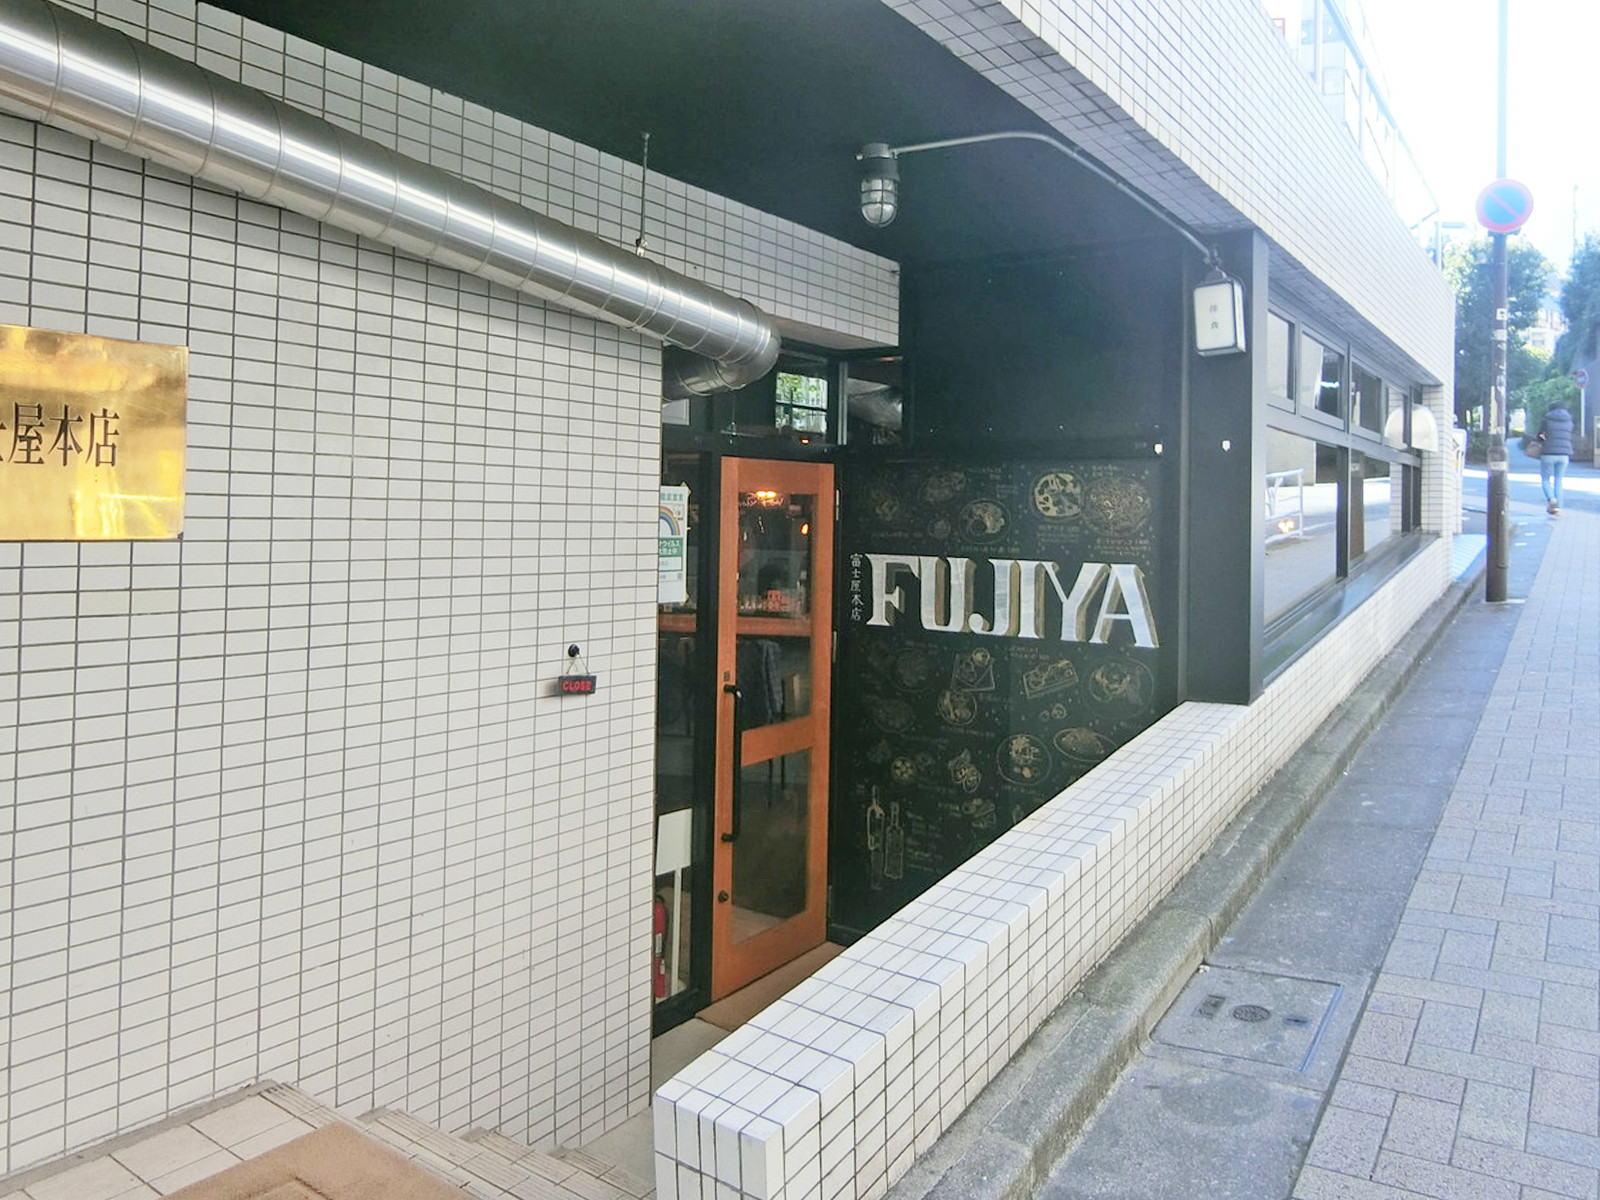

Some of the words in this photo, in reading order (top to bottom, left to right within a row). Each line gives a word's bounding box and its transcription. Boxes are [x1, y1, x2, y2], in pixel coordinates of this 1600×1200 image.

[0, 402, 120, 467] 屋本店
[849, 552, 864, 621] 富士屋本店
[866, 553, 1160, 649] FUJIYA
[562, 680, 592, 692] CLOSE
